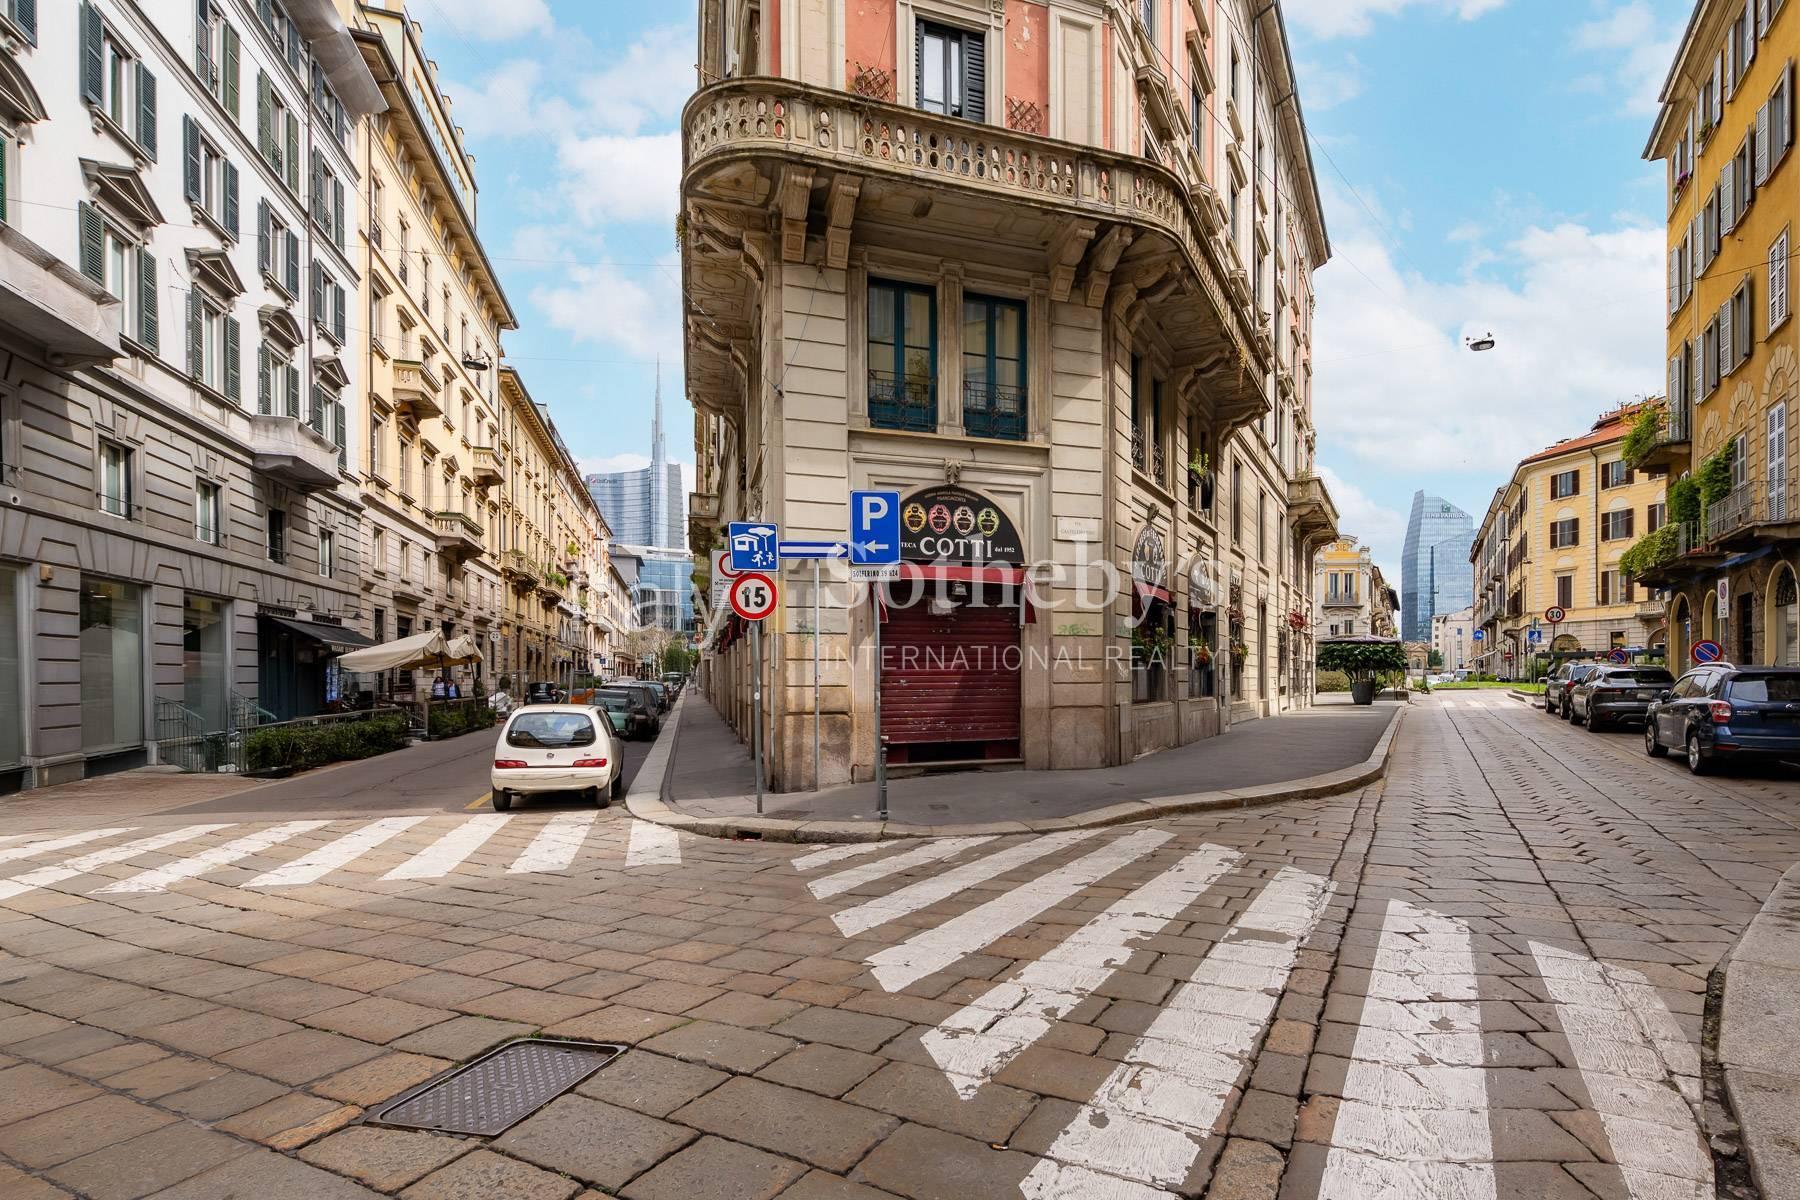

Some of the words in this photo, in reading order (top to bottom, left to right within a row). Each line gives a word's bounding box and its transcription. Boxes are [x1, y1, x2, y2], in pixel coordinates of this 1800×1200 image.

[862, 496, 888, 530] P
[901, 541, 917, 549] TECA
[919, 536, 992, 558] COTTI
[741, 586, 766, 608] 15
[1549, 610, 1561, 619] 30
